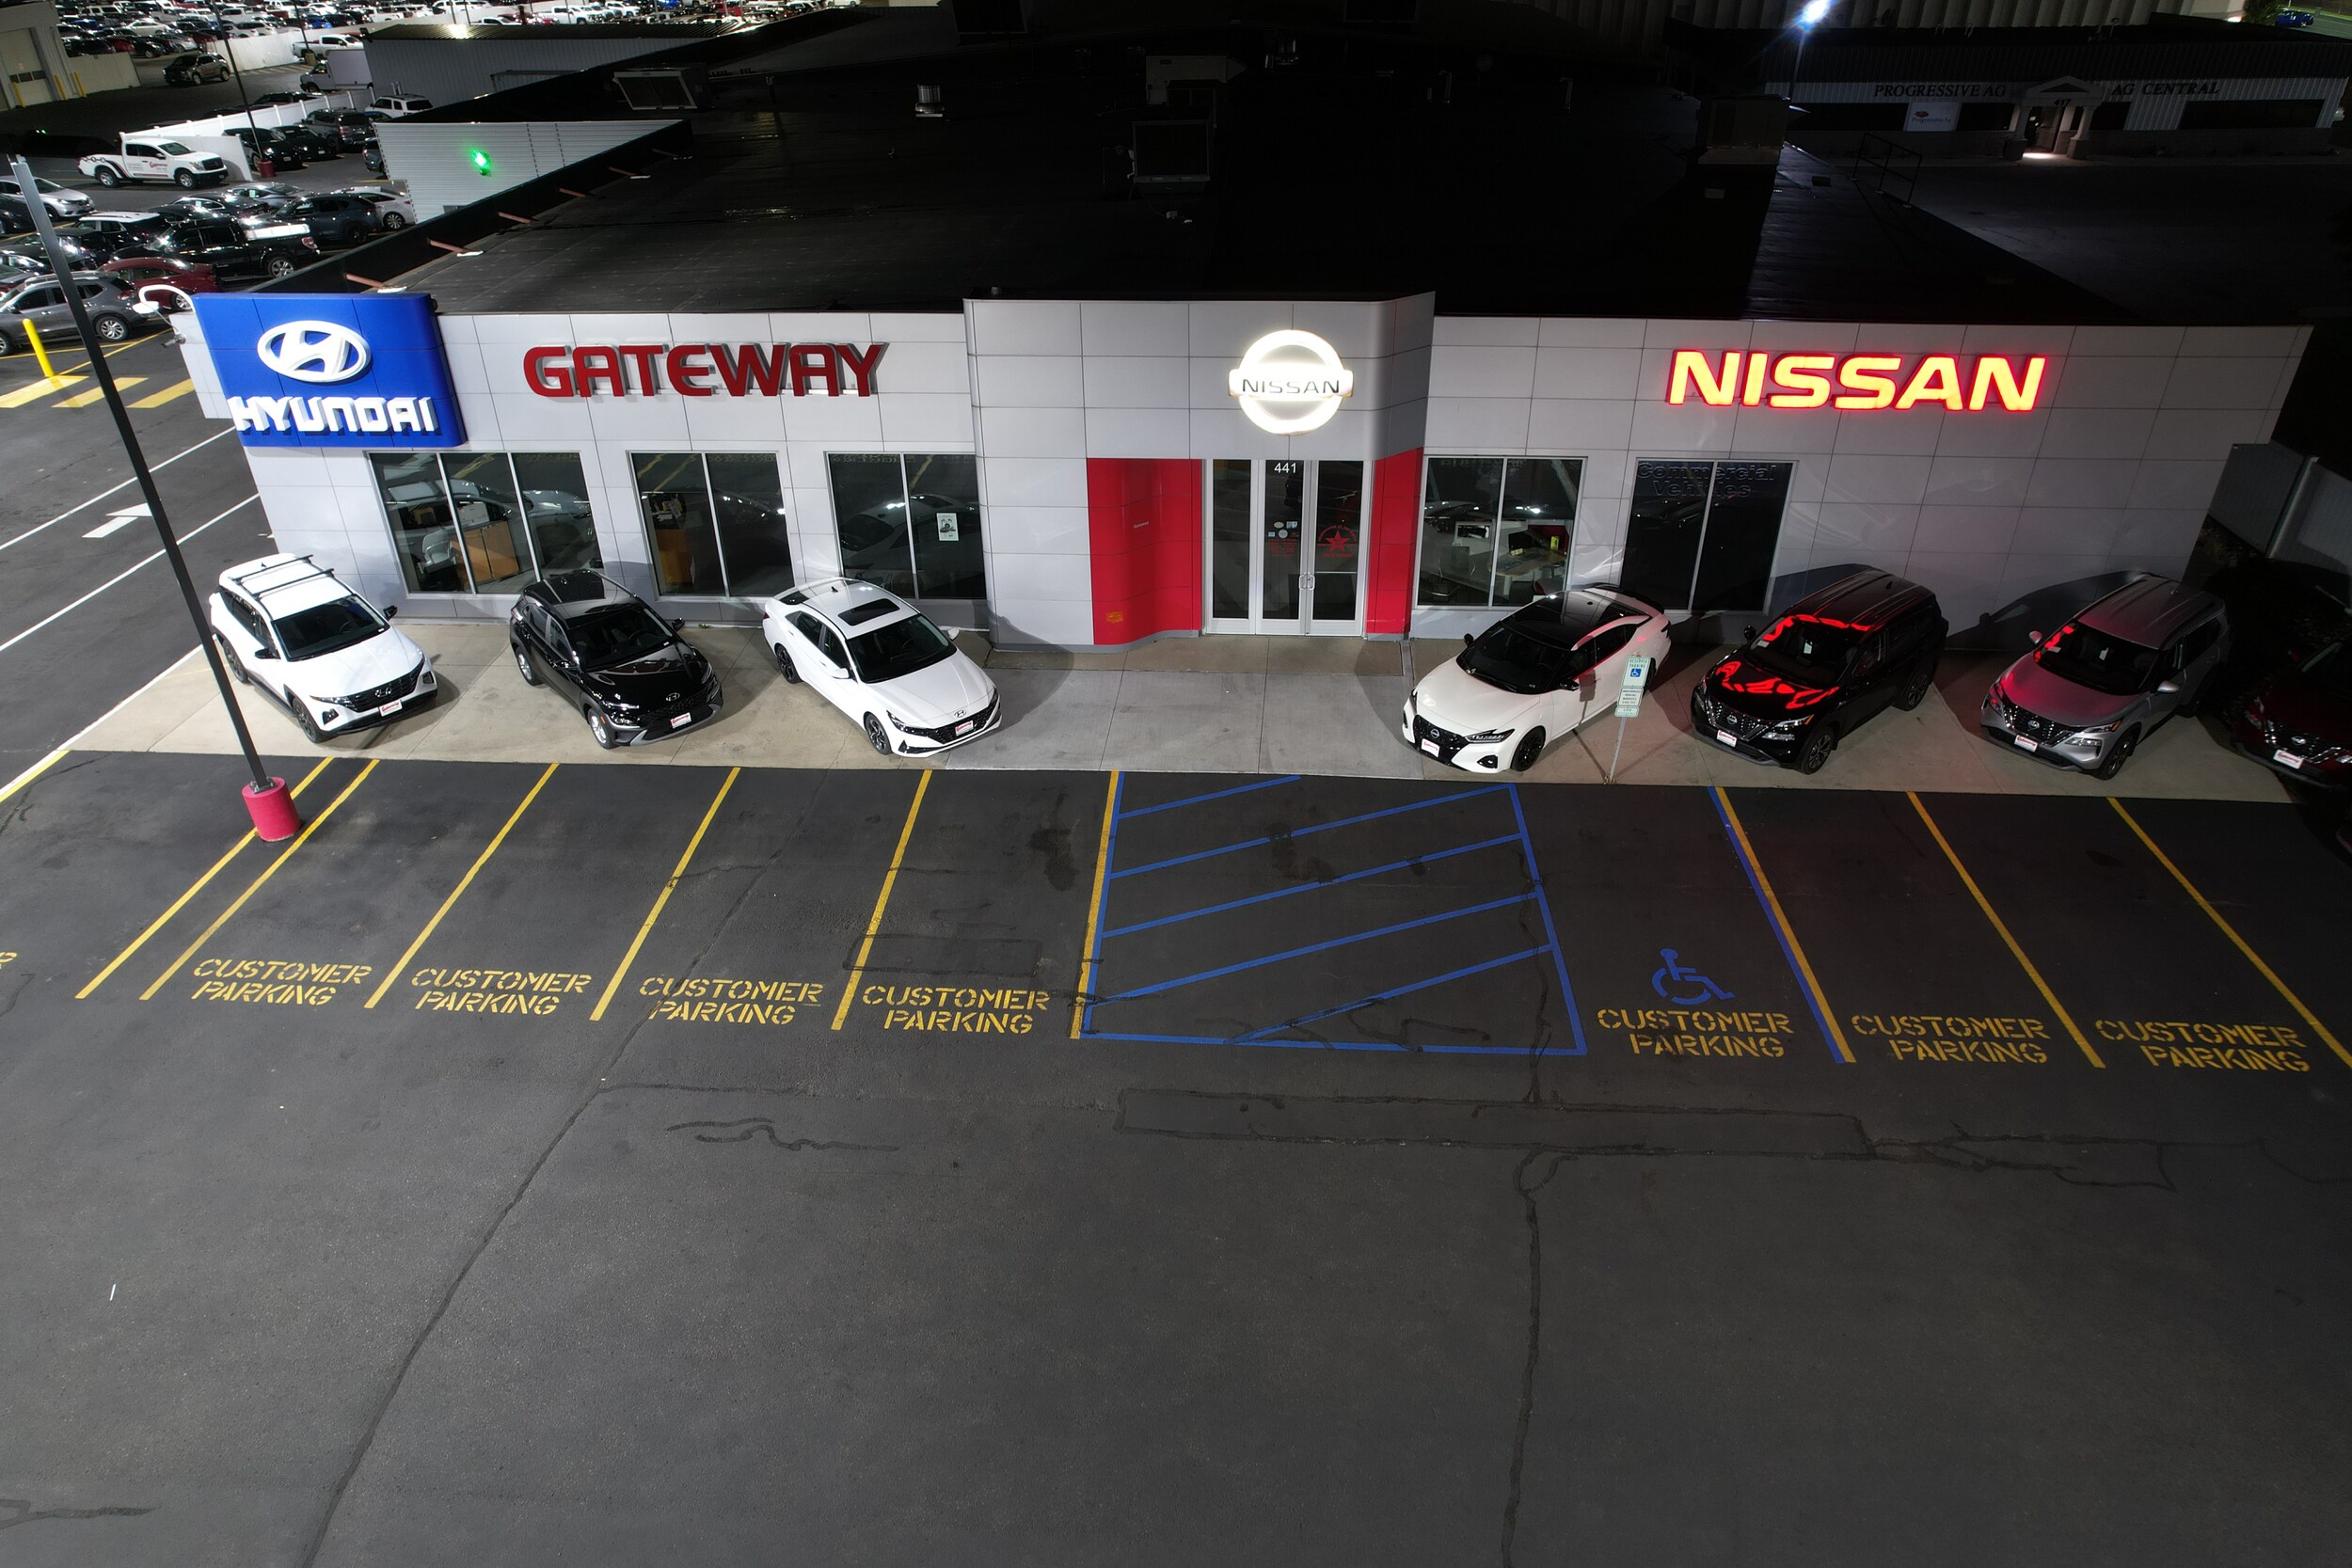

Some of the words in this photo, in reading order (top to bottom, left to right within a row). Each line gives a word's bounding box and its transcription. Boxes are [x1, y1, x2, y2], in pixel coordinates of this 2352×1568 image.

[1874, 85, 1980, 97] PROGRESSIVE
[1983, 85, 2006, 96] AG
[2112, 84, 2135, 95] AG
[2142, 83, 2219, 95] CENTRAL
[523, 343, 886, 398] GATEWAY
[1667, 349, 2048, 412] NISSAN
[1242, 378, 1340, 394] NISSAN
[230, 395, 438, 434] HYUNDAI
[1274, 462, 1297, 474] 441
[1637, 462, 1776, 481] Commercial
[193, 958, 372, 985] CUSTOMER
[411, 968, 592, 994] CUSTOMER
[191, 981, 337, 1006] PARKING
[415, 990, 560, 1016] PARKING
[639, 976, 824, 1004] CUSTOMER
[862, 985, 1050, 1011] CUSTOMER
[648, 1000, 796, 1025] PARKING
[883, 1009, 1034, 1035] PARKING
[1597, 1008, 1794, 1035] CUSTOMER
[1851, 1015, 2050, 1040] CUSTOMER
[2095, 1020, 2308, 1048] CUSTOMER
[1629, 1033, 1785, 1058] PARKING
[1889, 1039, 2048, 1065] PARKING
[2140, 1045, 2310, 1071] PARKING
